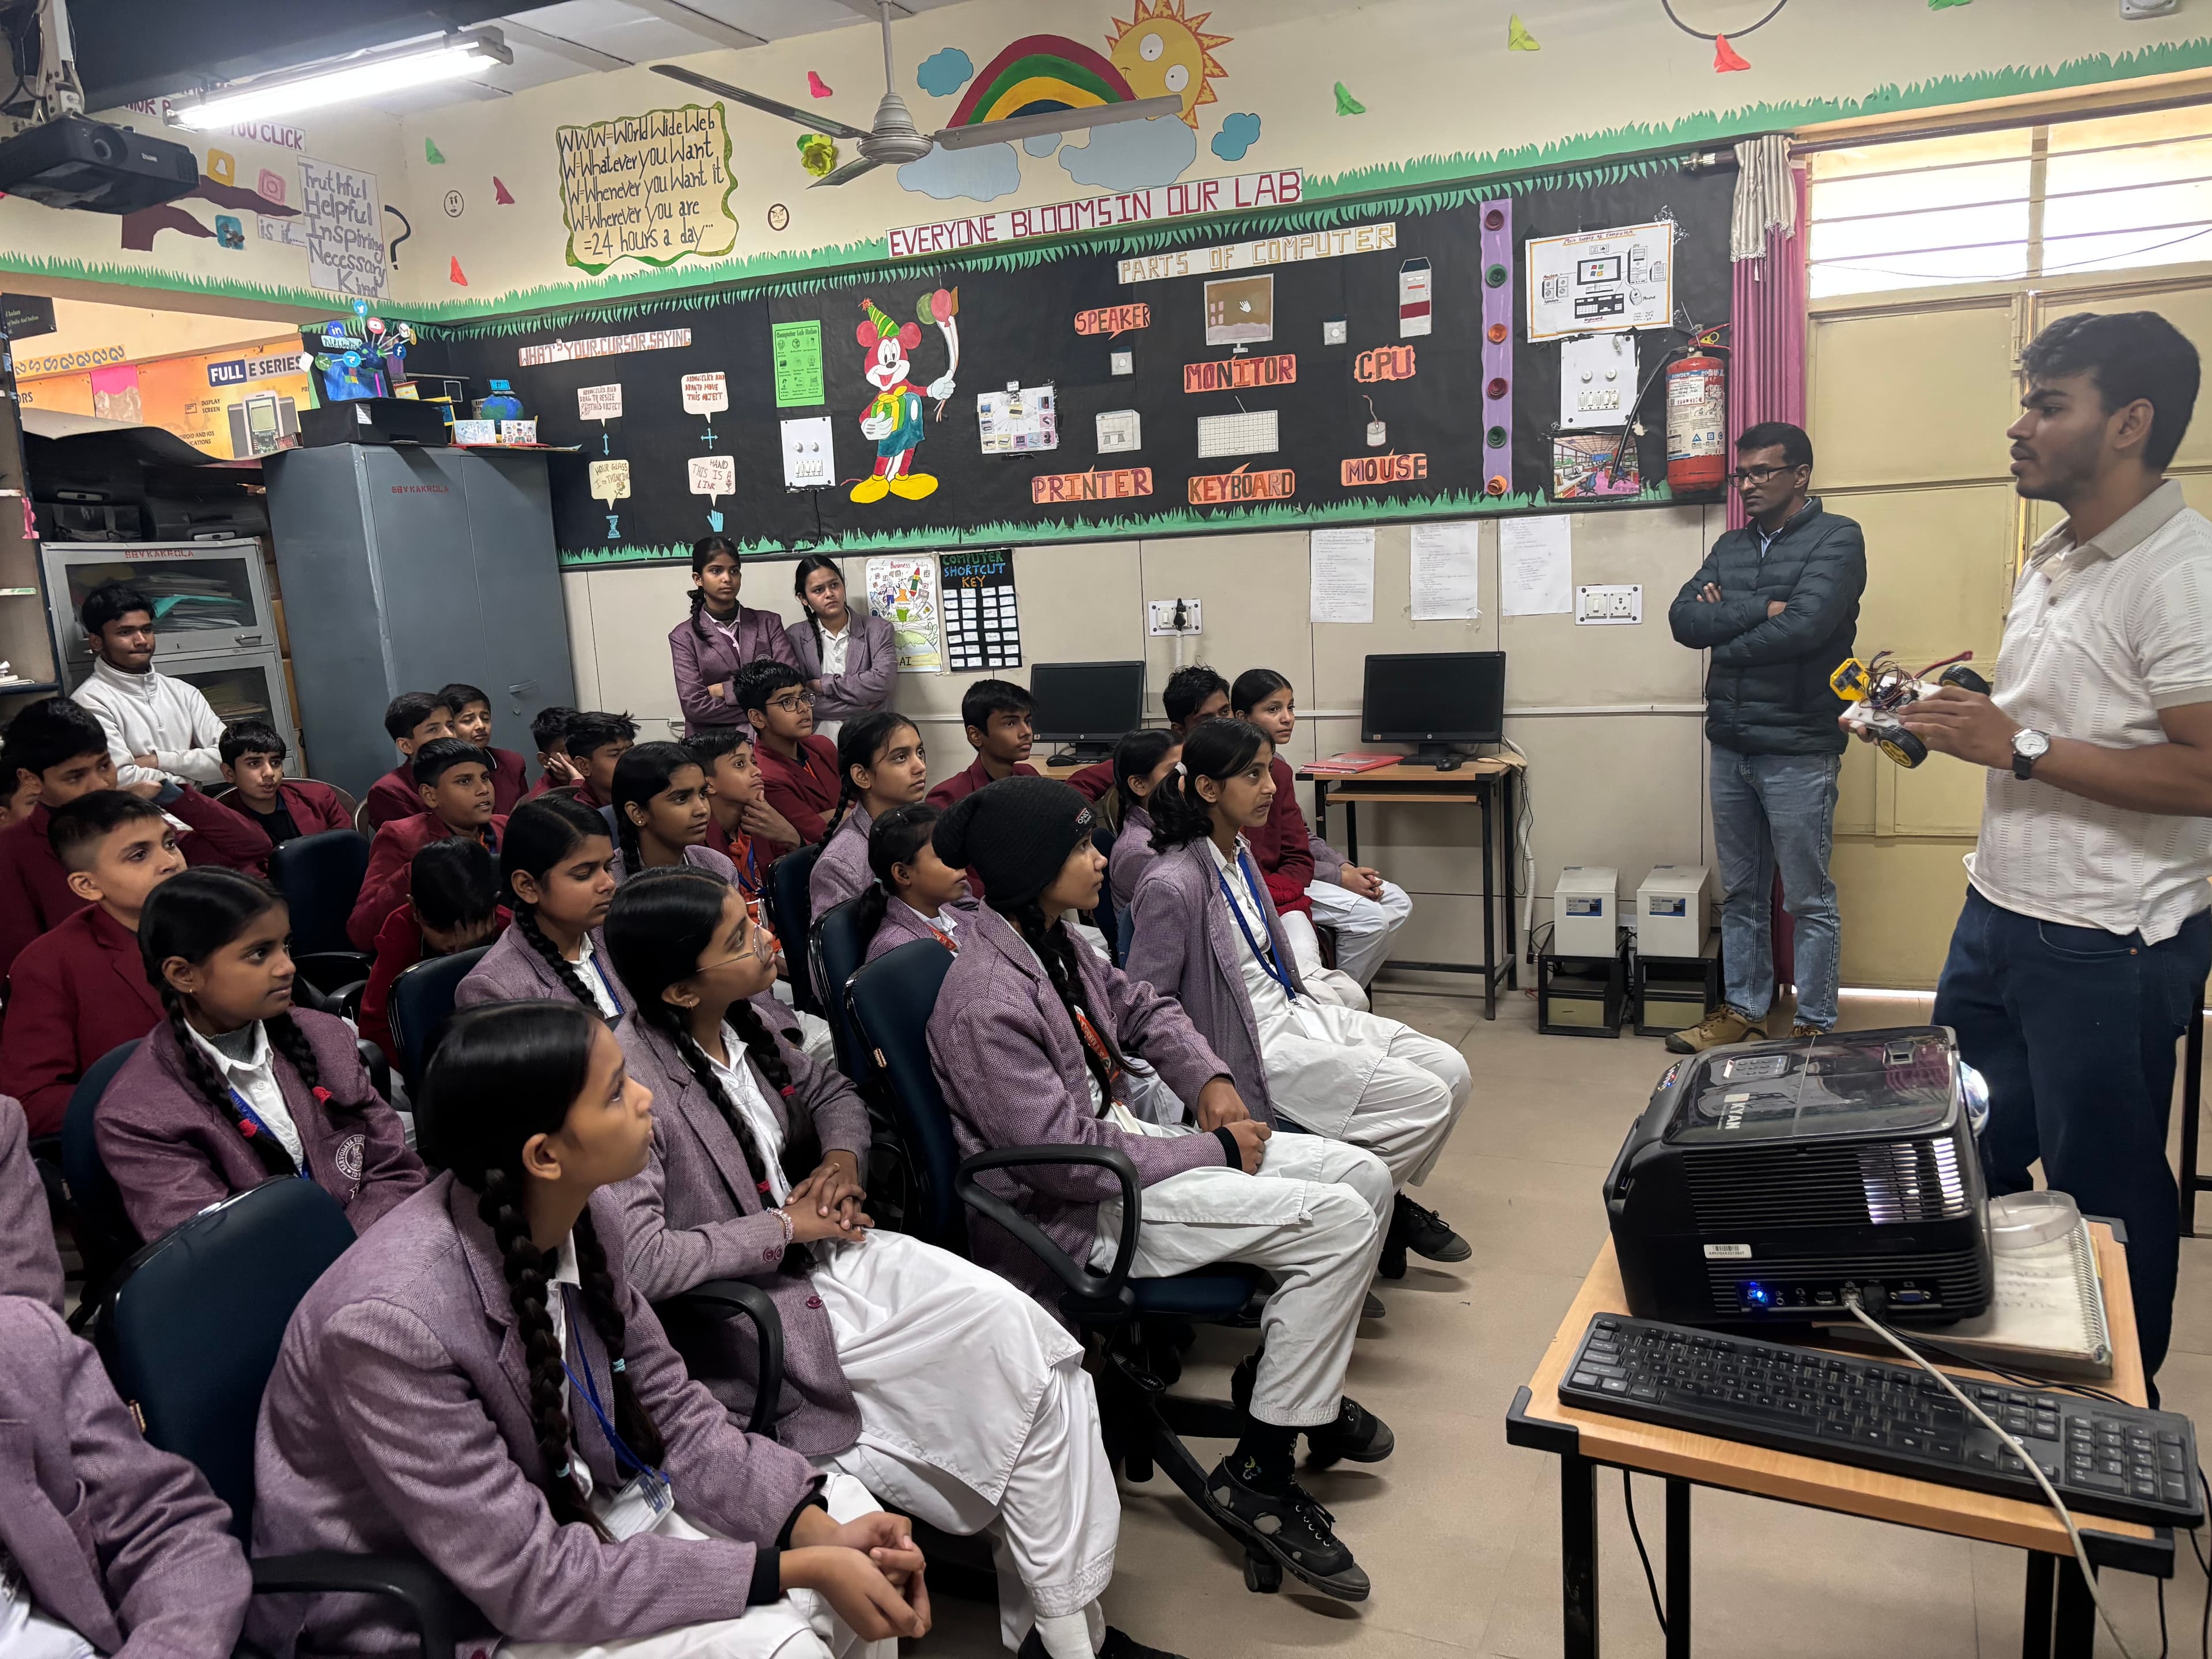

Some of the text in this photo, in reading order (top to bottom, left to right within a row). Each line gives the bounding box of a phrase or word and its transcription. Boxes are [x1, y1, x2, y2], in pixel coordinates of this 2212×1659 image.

[260, 124, 302, 150] CLICK
[651, 111, 683, 139] Wide
[685, 109, 715, 134] Web
[638, 147, 669, 180] you
[670, 131, 714, 163] Want
[297, 162, 367, 200] Truthful
[644, 175, 669, 208] you
[670, 160, 708, 191] Want
[712, 156, 724, 185] it
[304, 188, 373, 226] Helpful
[645, 202, 673, 234] you
[679, 200, 700, 217] are
[889, 215, 997, 257] EVERYONE
[1167, 180, 1219, 215] OUR
[1235, 171, 1301, 207] LAB
[260, 219, 274, 241] is
[303, 212, 384, 264] Inspiring
[619, 226, 659, 252] hours
[663, 228, 673, 247] a
[308, 238, 386, 288] Necessary
[1121, 224, 1395, 283] PARTS OF COMPUTER
[337, 268, 378, 298] Kind
[1075, 305, 1150, 333] SPEAKER
[210, 355, 302, 382] FULL E SERIES
[1185, 355, 1294, 390] MONITOR
[1358, 349, 1412, 380] CPU
[594, 463, 628, 476] HOUR GLASS
[692, 464, 708, 478] THIS
[713, 470, 723, 480] IS
[710, 459, 729, 469] HAND
[1344, 455, 1427, 482] MOUSE
[698, 480, 716, 490] LINK
[1033, 468, 1152, 503] PRINTER
[1190, 471, 1294, 502] KEYBOARD
[890, 561, 911, 569] Business
[942, 551, 1005, 566] COMPUTER
[944, 563, 1006, 577] SHORTCUT
[899, 657, 912, 666] AI
[1725, 1102, 1747, 1130] KYAN
